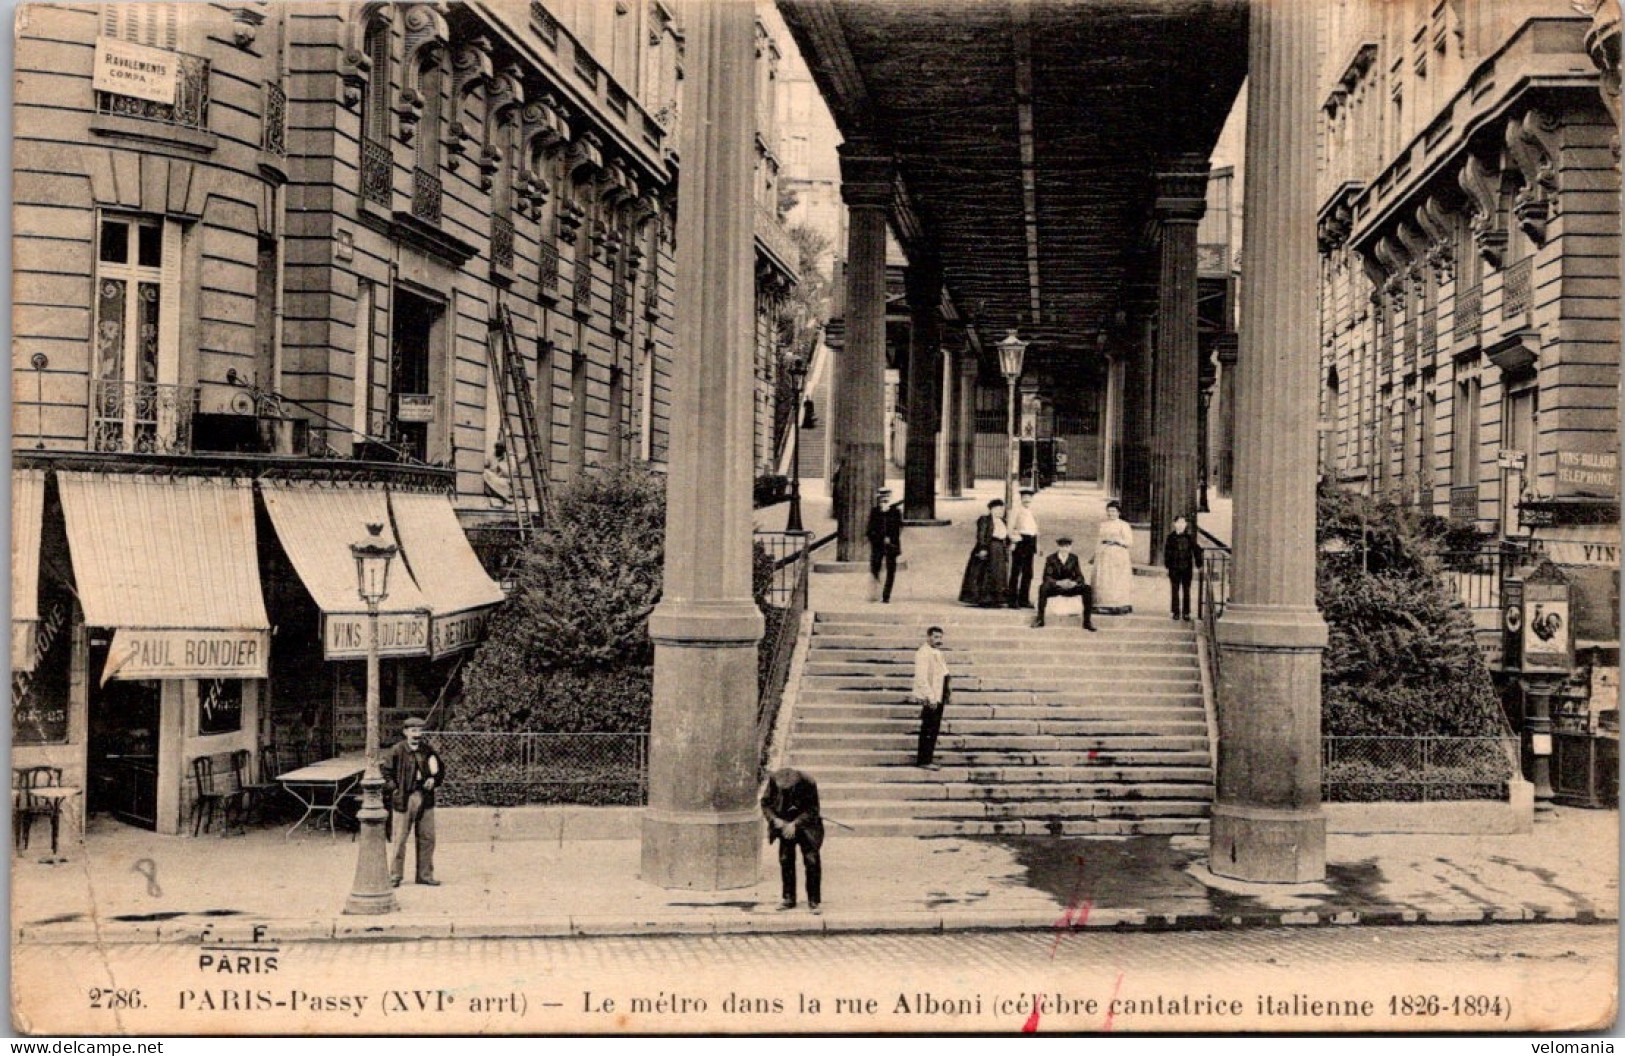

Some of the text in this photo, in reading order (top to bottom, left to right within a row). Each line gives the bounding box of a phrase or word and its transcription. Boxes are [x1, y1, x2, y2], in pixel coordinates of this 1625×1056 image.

[333, 622, 362, 649] VINS
[130, 639, 258, 667] PAUL RONDIER
